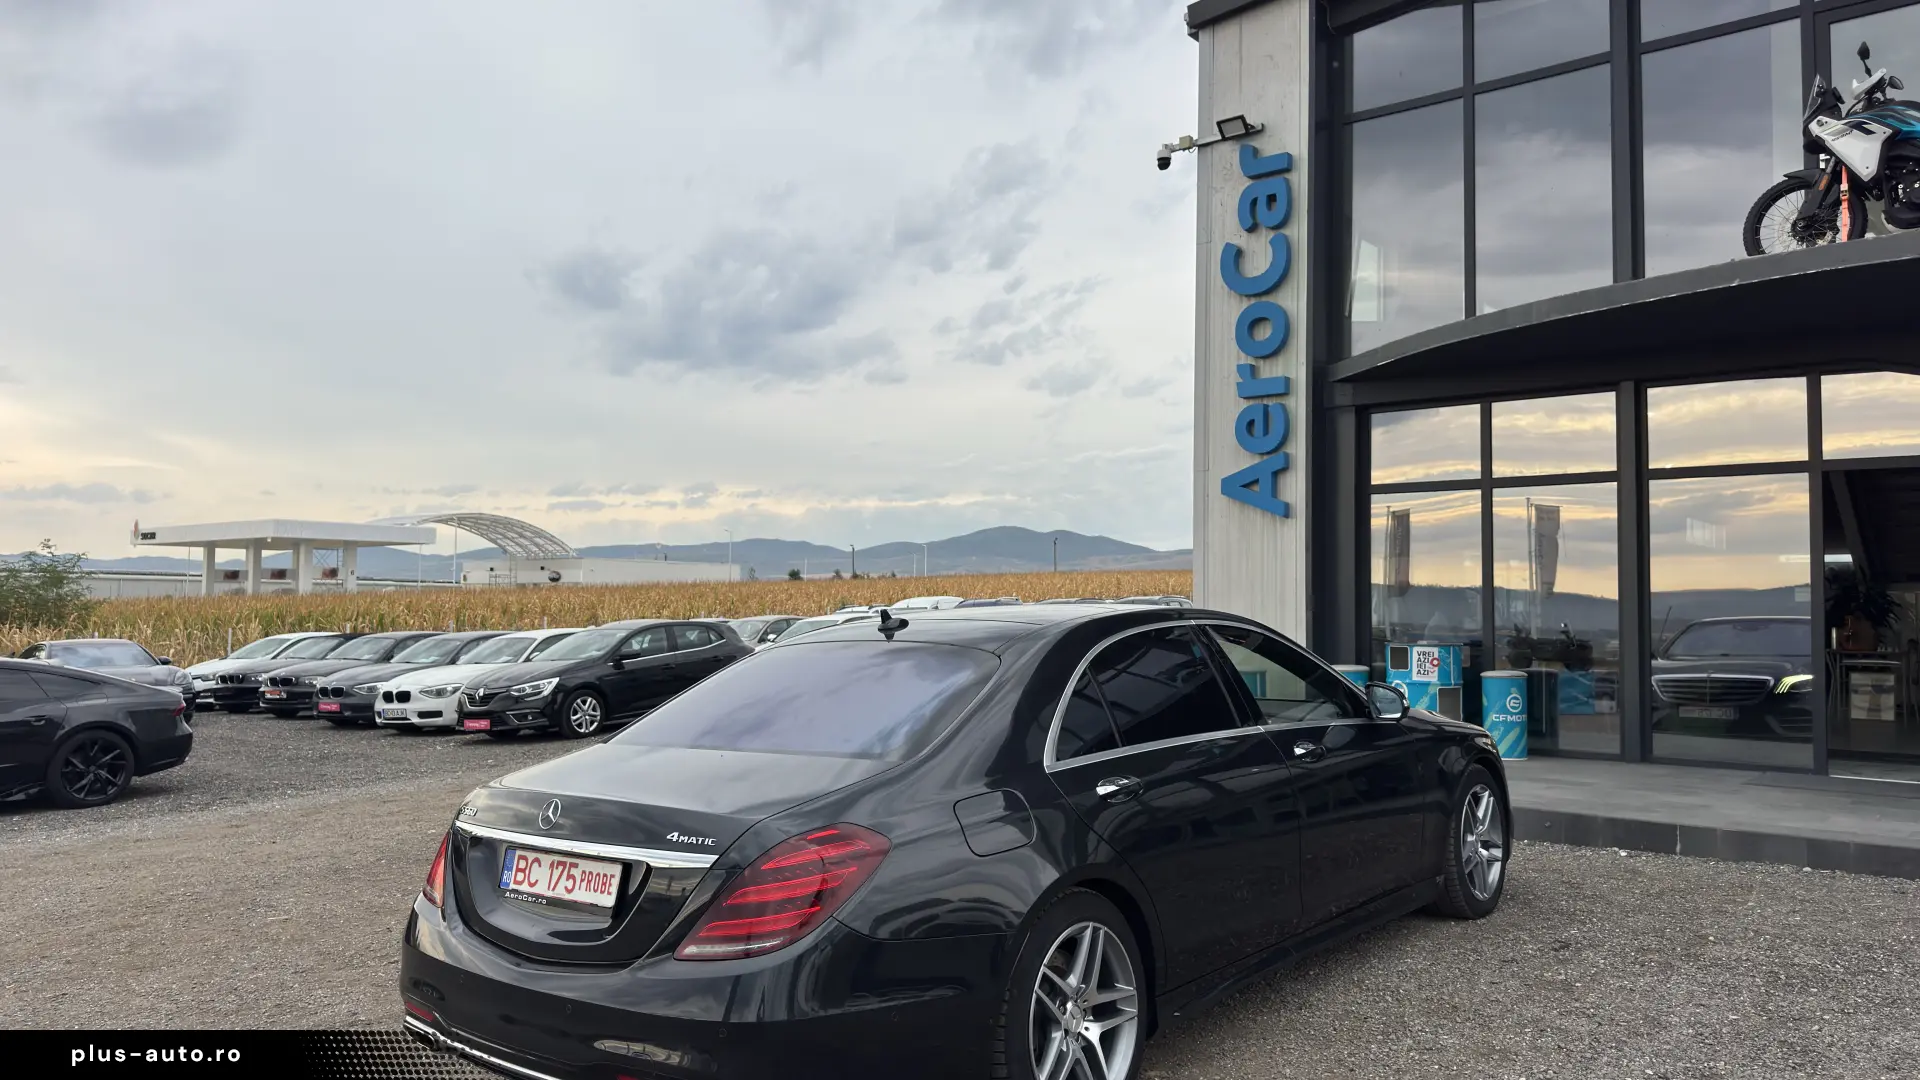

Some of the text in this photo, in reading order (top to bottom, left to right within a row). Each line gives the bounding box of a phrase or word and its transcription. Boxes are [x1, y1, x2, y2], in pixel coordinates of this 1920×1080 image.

[1220, 143, 1293, 519] AeroCar
[1416, 650, 1435, 658] VREI
[666, 831, 717, 846] 4MATIC
[502, 870, 512, 883] RO
[512, 854, 617, 896] BC 175 PROBE
[504, 891, 547, 905] AeroCar.ro
